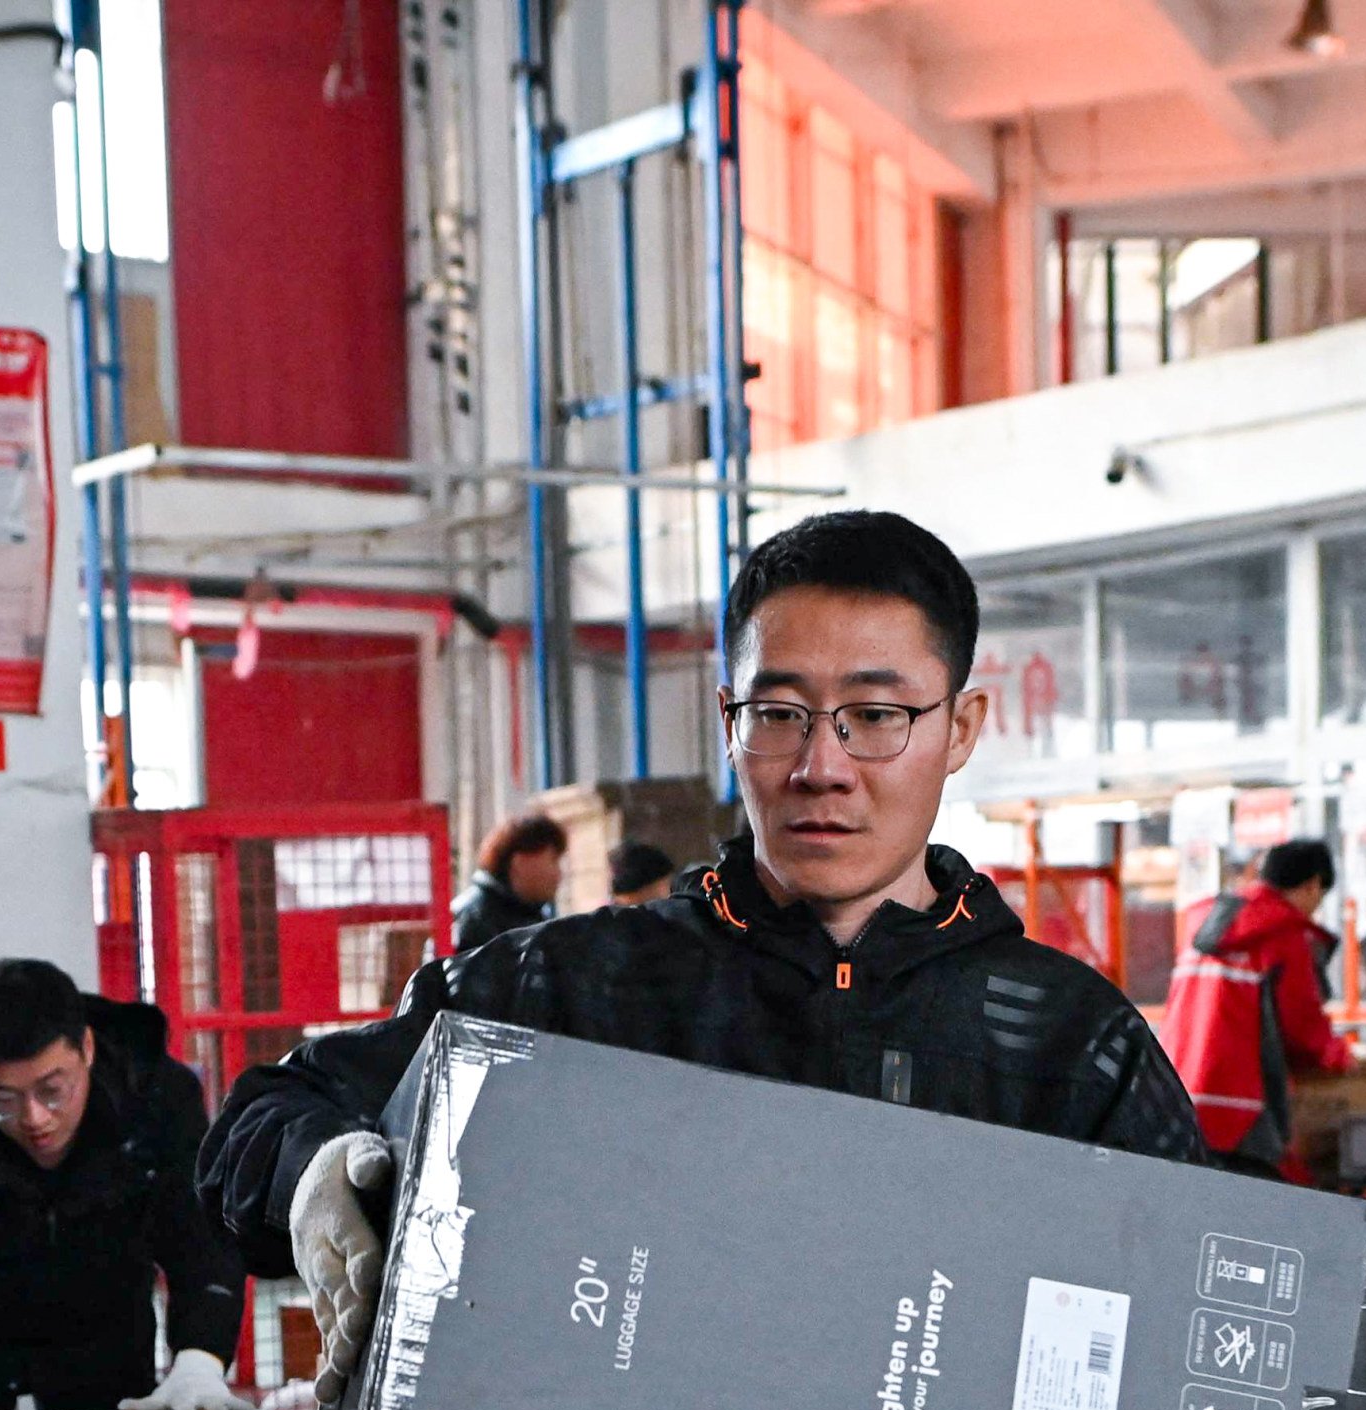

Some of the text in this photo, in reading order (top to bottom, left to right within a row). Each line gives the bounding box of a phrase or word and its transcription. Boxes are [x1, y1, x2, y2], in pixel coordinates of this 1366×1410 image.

[570, 1256, 609, 1329] 20"
[614, 1245, 649, 1371] LUGGAGE SIZE
[895, 1297, 920, 1333] up
[911, 1268, 954, 1378] journey
